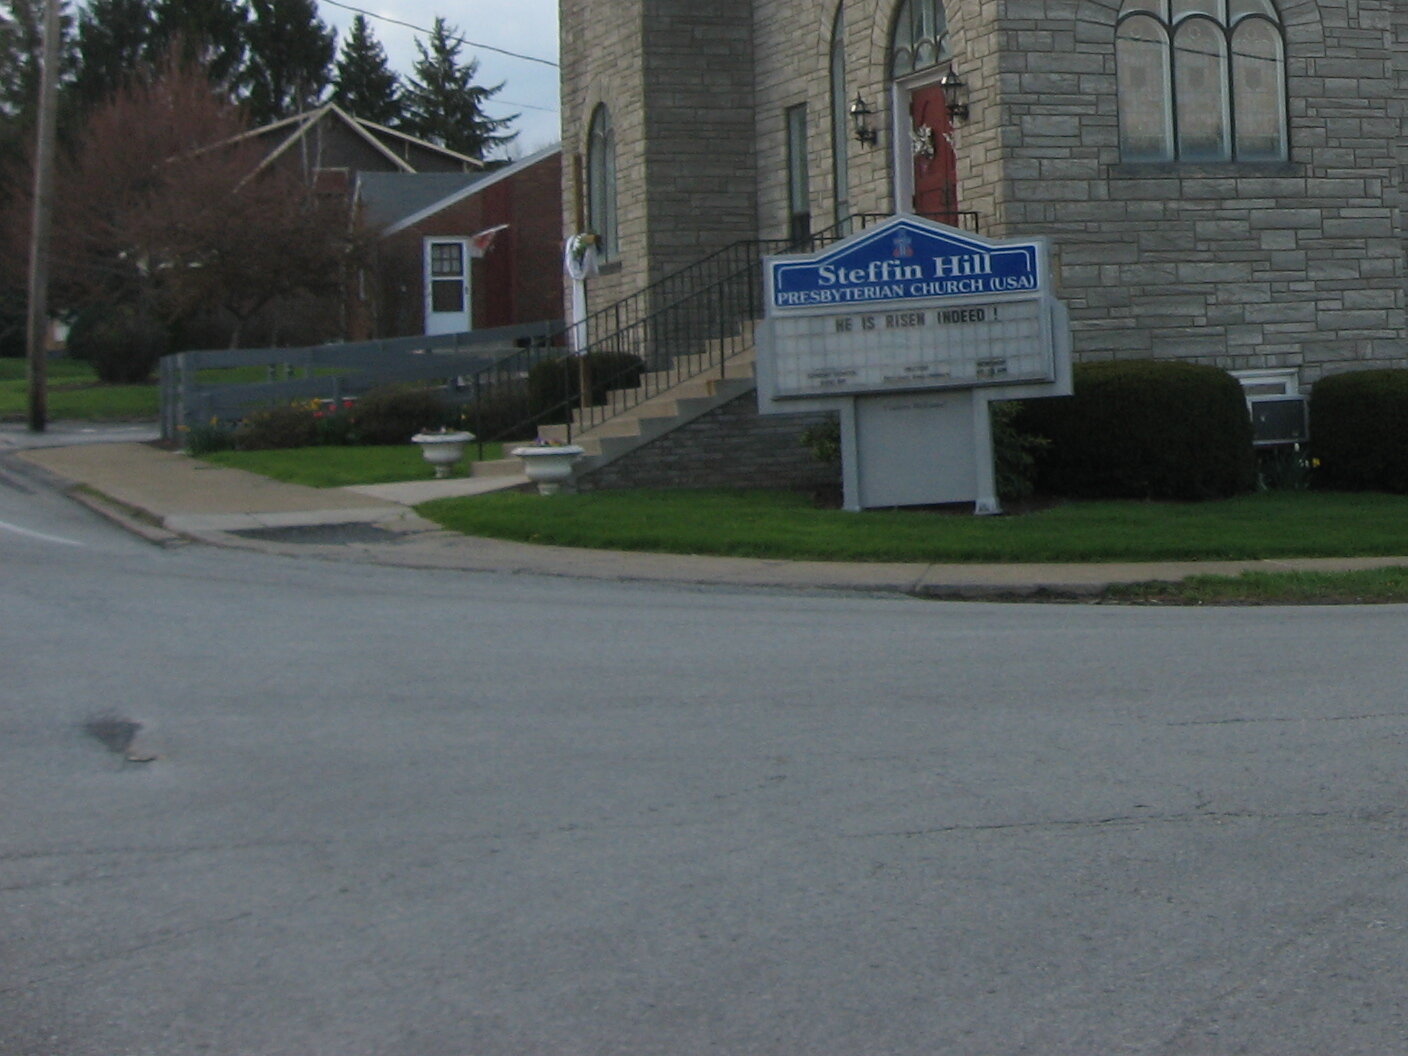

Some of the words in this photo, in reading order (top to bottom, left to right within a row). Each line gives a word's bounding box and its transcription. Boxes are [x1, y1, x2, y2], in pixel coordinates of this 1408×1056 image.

[818, 259, 923, 286] Steffin
[933, 253, 992, 278] Hill
[777, 284, 904, 305] PRESBYTERIAN
[911, 278, 983, 296] CHURCH
[990, 273, 1034, 292] (USA)
[836, 318, 852, 332] HE
[862, 317, 875, 330] IS
[886, 312, 926, 328] RISEN
[937, 308, 985, 324] INDEED
